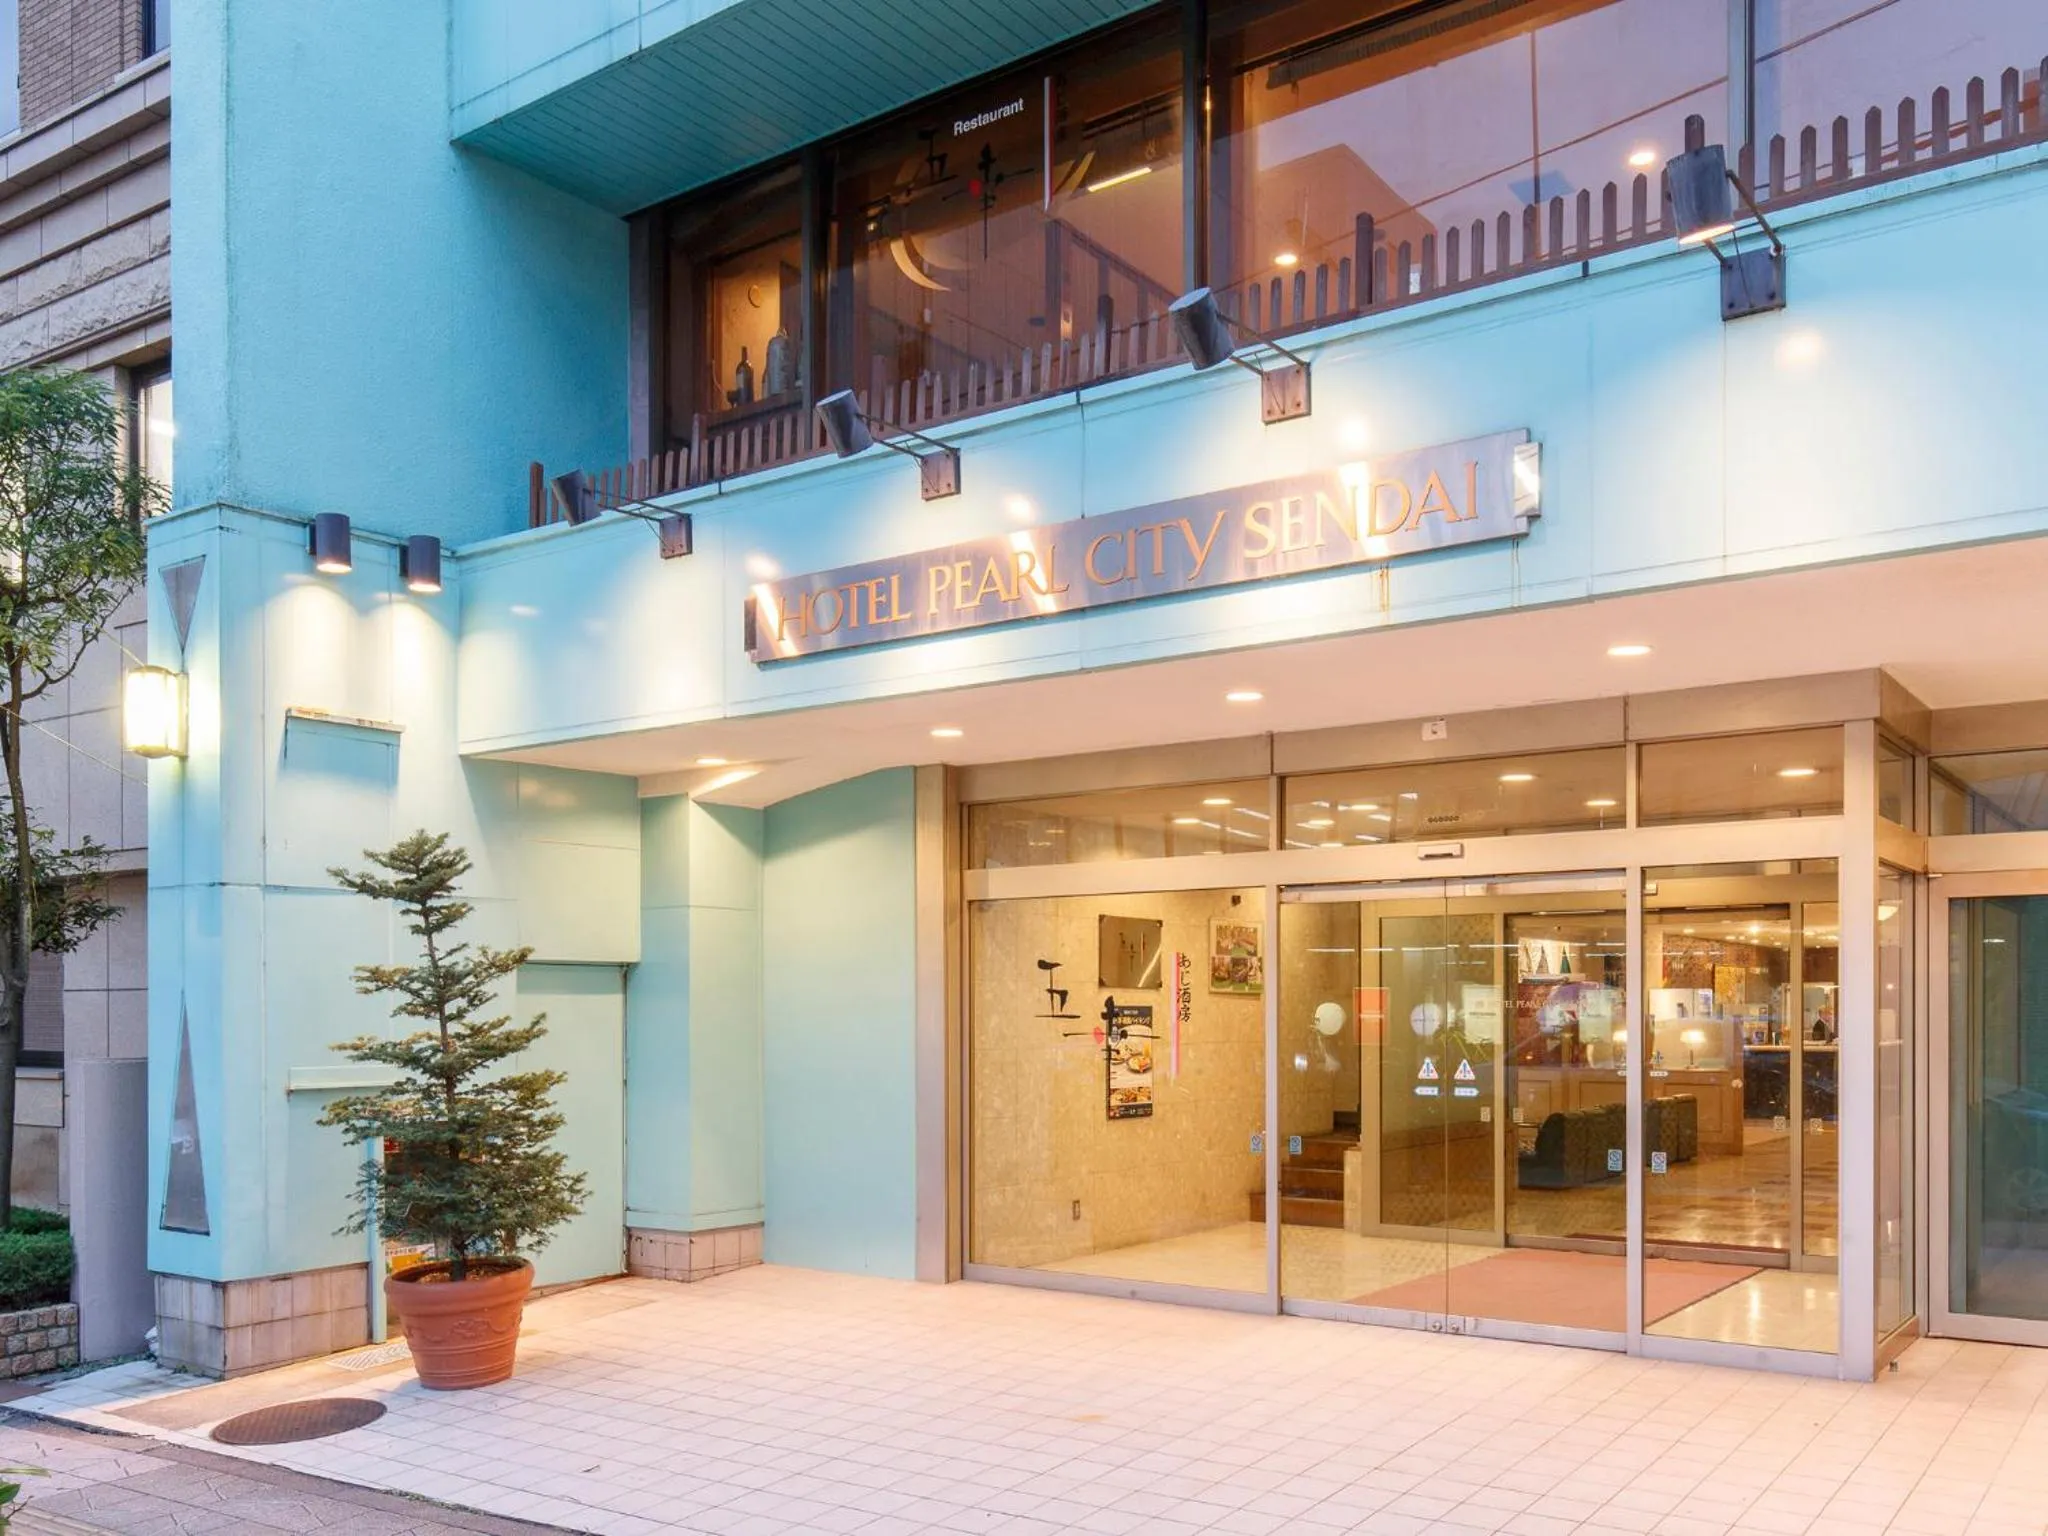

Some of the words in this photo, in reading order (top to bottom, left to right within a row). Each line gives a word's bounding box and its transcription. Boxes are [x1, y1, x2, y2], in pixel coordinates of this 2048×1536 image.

[953, 97, 1024, 136] Restaurant
[778, 573, 912, 641] HOTEL
[927, 545, 1070, 616] PEARL
[1084, 510, 1227, 586] CITY
[1243, 461, 1479, 560] SENDAI
